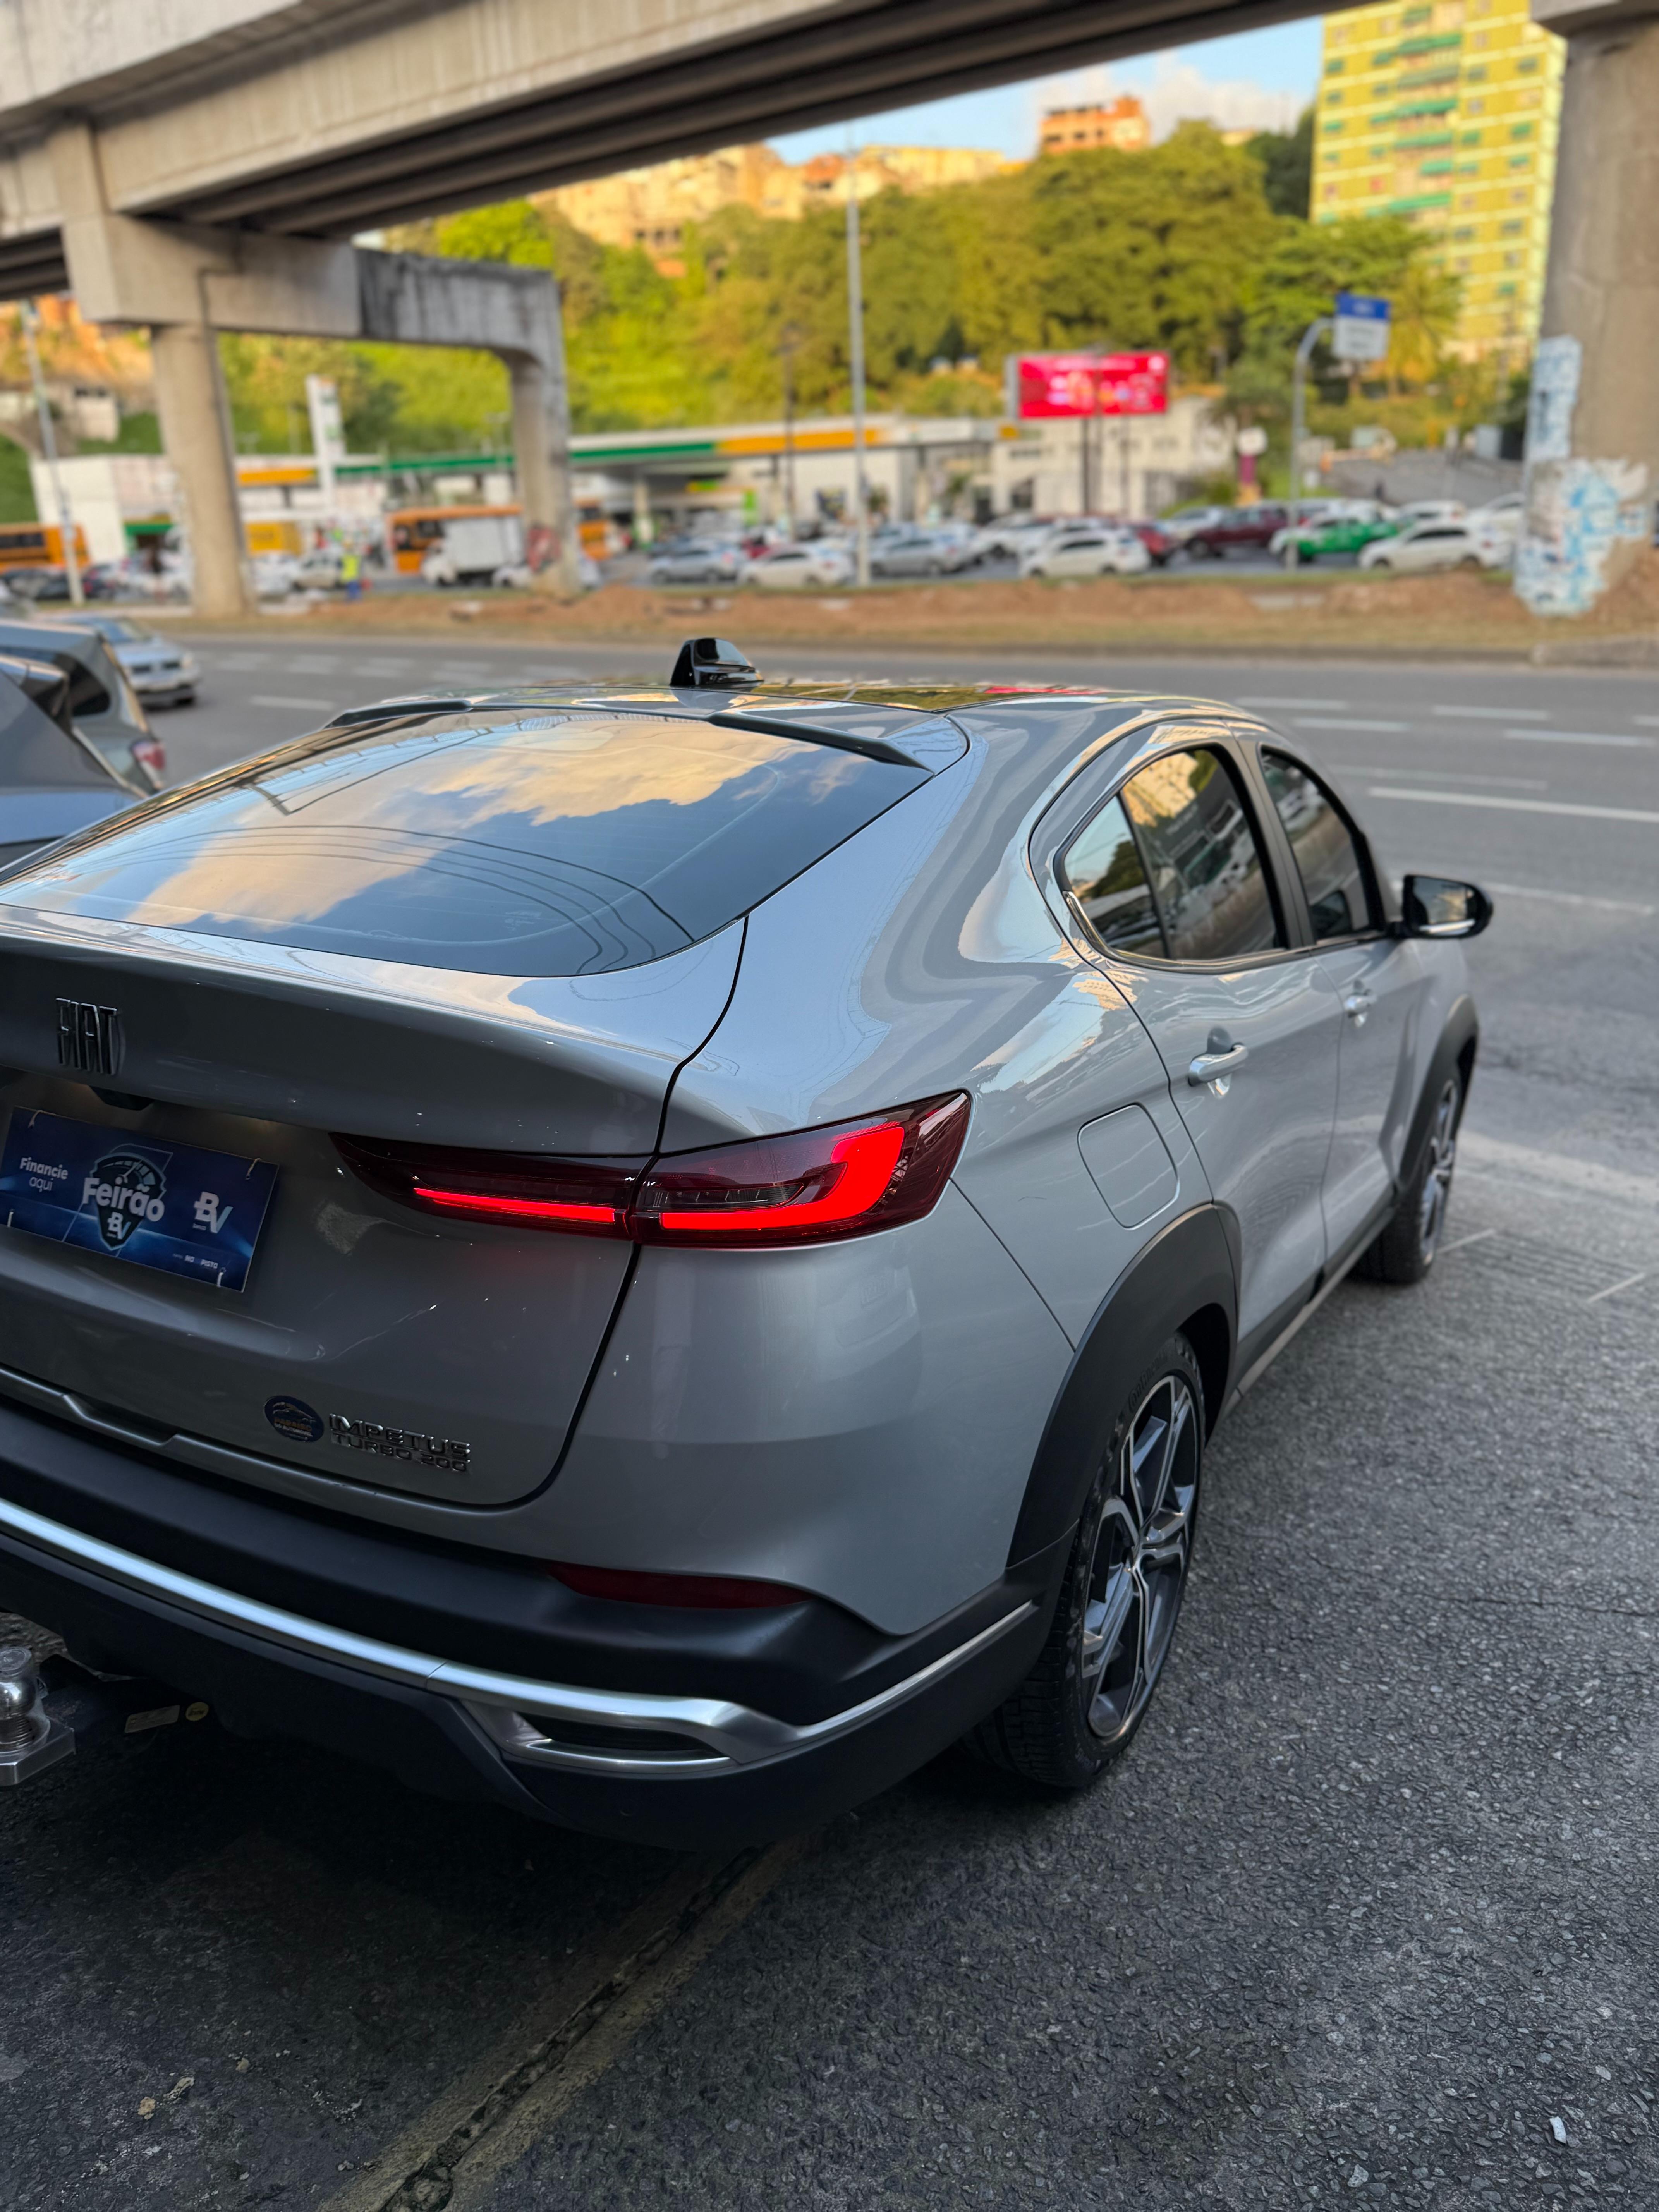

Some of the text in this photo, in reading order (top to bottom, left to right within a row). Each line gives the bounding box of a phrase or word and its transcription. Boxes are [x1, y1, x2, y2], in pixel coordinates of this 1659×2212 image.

[55, 997, 117, 1075] FIAT
[19, 1156, 69, 1180] Financie
[29, 1175, 53, 1192] aqui
[82, 1175, 165, 1222] Feirão
[194, 1191, 233, 1233] BV
[107, 1212, 131, 1239] BV
[329, 1413, 471, 1457] IMPETUS
[330, 1432, 470, 1472] TURBO 200
